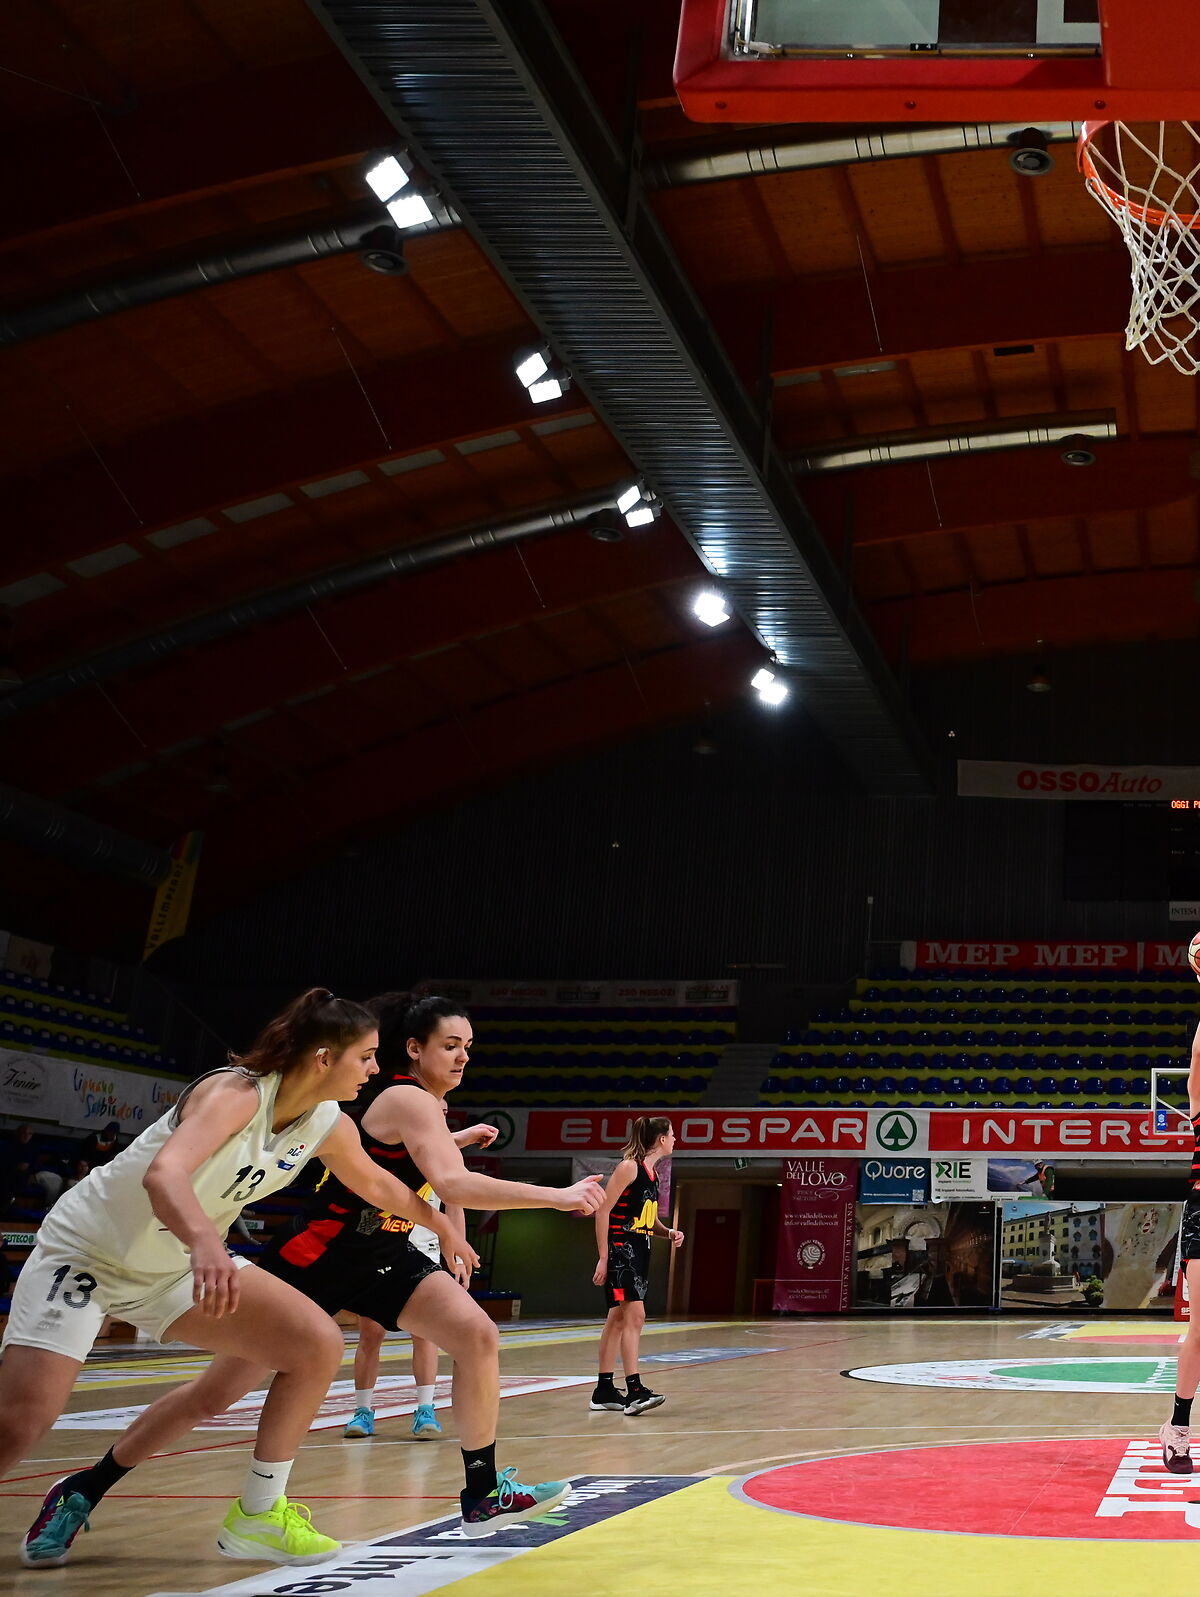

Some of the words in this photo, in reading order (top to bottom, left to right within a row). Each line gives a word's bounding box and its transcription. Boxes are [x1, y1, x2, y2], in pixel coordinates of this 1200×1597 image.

[1171, 800, 1189, 809] OGGI
[924, 942, 1020, 966] MEP
[1034, 943, 1128, 967] MEP
[561, 1118, 863, 1143] EUOSPAR
[787, 1160, 825, 1172] VALLE
[864, 1160, 926, 1181] Quore
[936, 1161, 972, 1179] RIE
[220, 1165, 266, 1202] 13
[786, 1172, 801, 1180] DEL
[800, 1172, 845, 1187] LOVO
[845, 1202, 854, 1247] MARANO
[844, 1251, 850, 1262] DI
[47, 1264, 98, 1309] 13
[842, 1266, 850, 1309] LAGUNA
